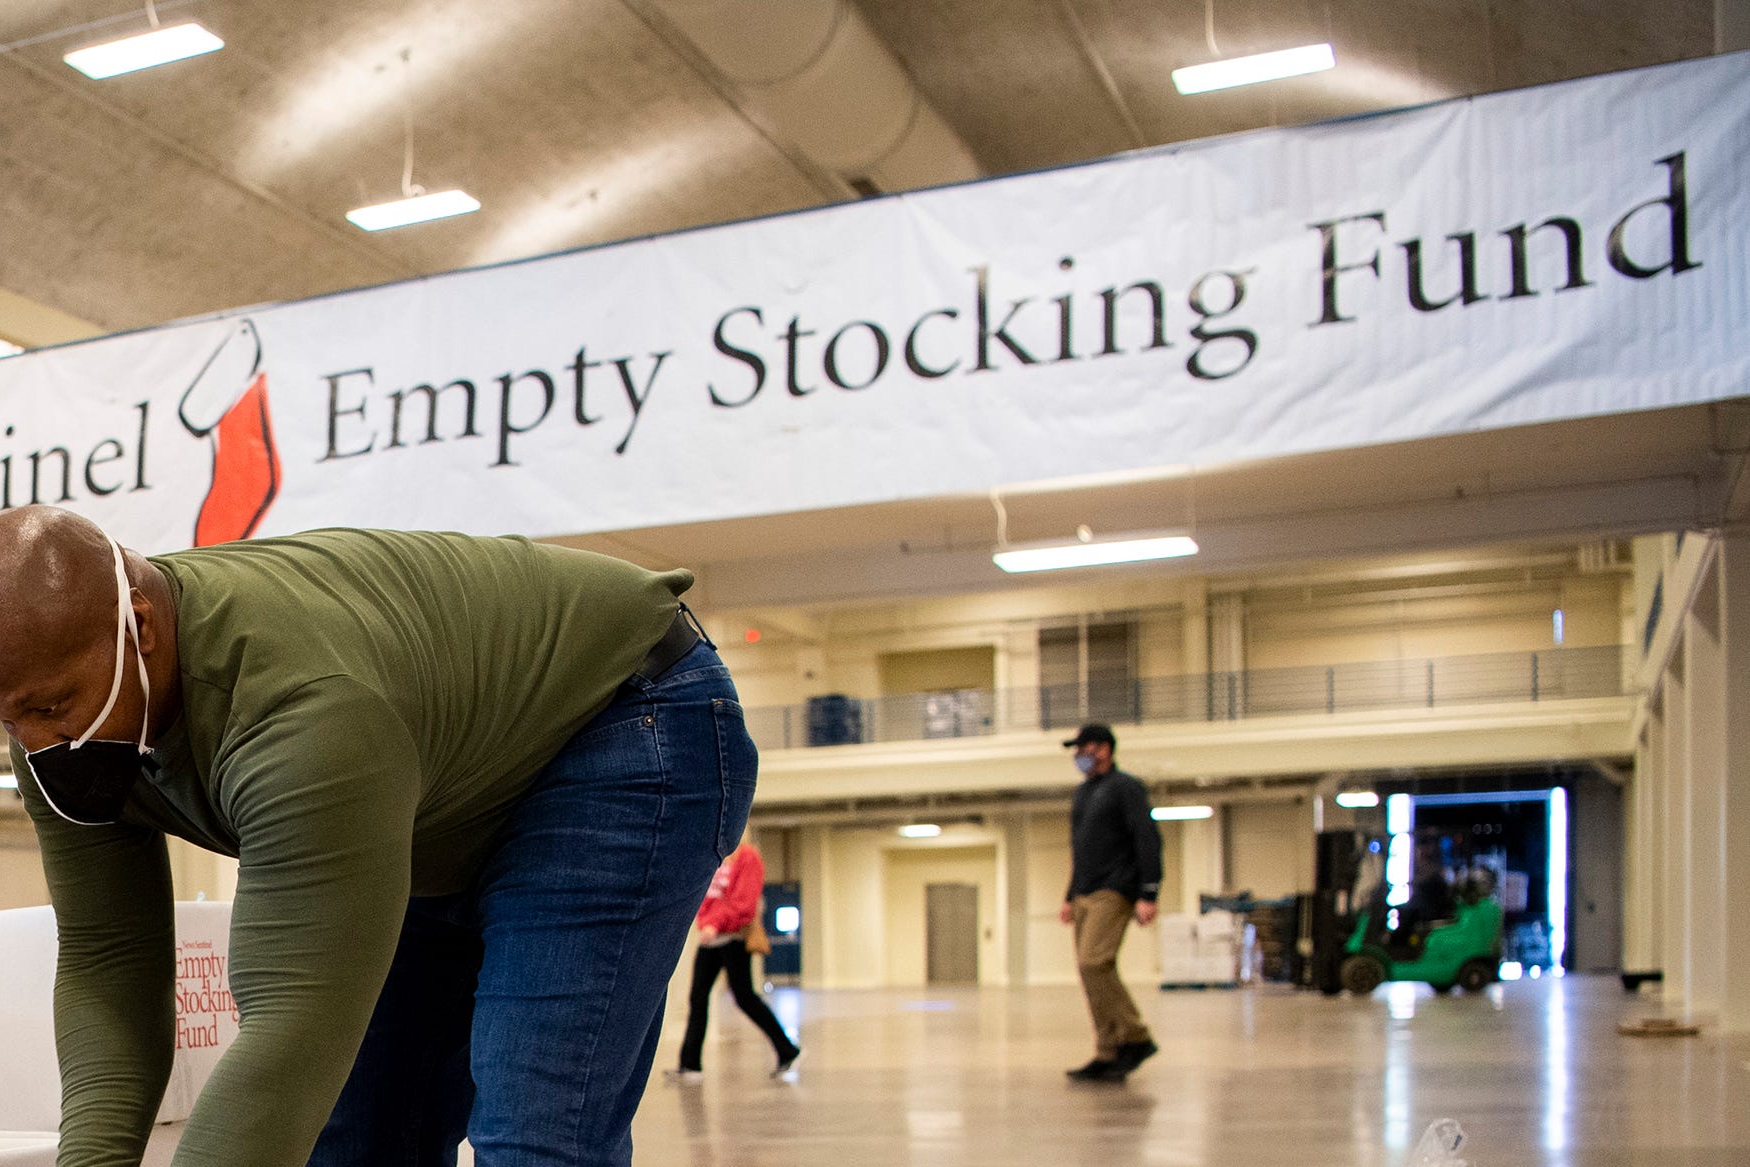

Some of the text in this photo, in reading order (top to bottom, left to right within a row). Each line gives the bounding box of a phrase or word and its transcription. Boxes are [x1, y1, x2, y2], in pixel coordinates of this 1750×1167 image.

[315, 346, 675, 468] Empty
[707, 255, 1258, 409] Stocking
[1306, 150, 1703, 328] Fund
[176, 948, 225, 989] Empty
[176, 1014, 218, 1049] Fund
